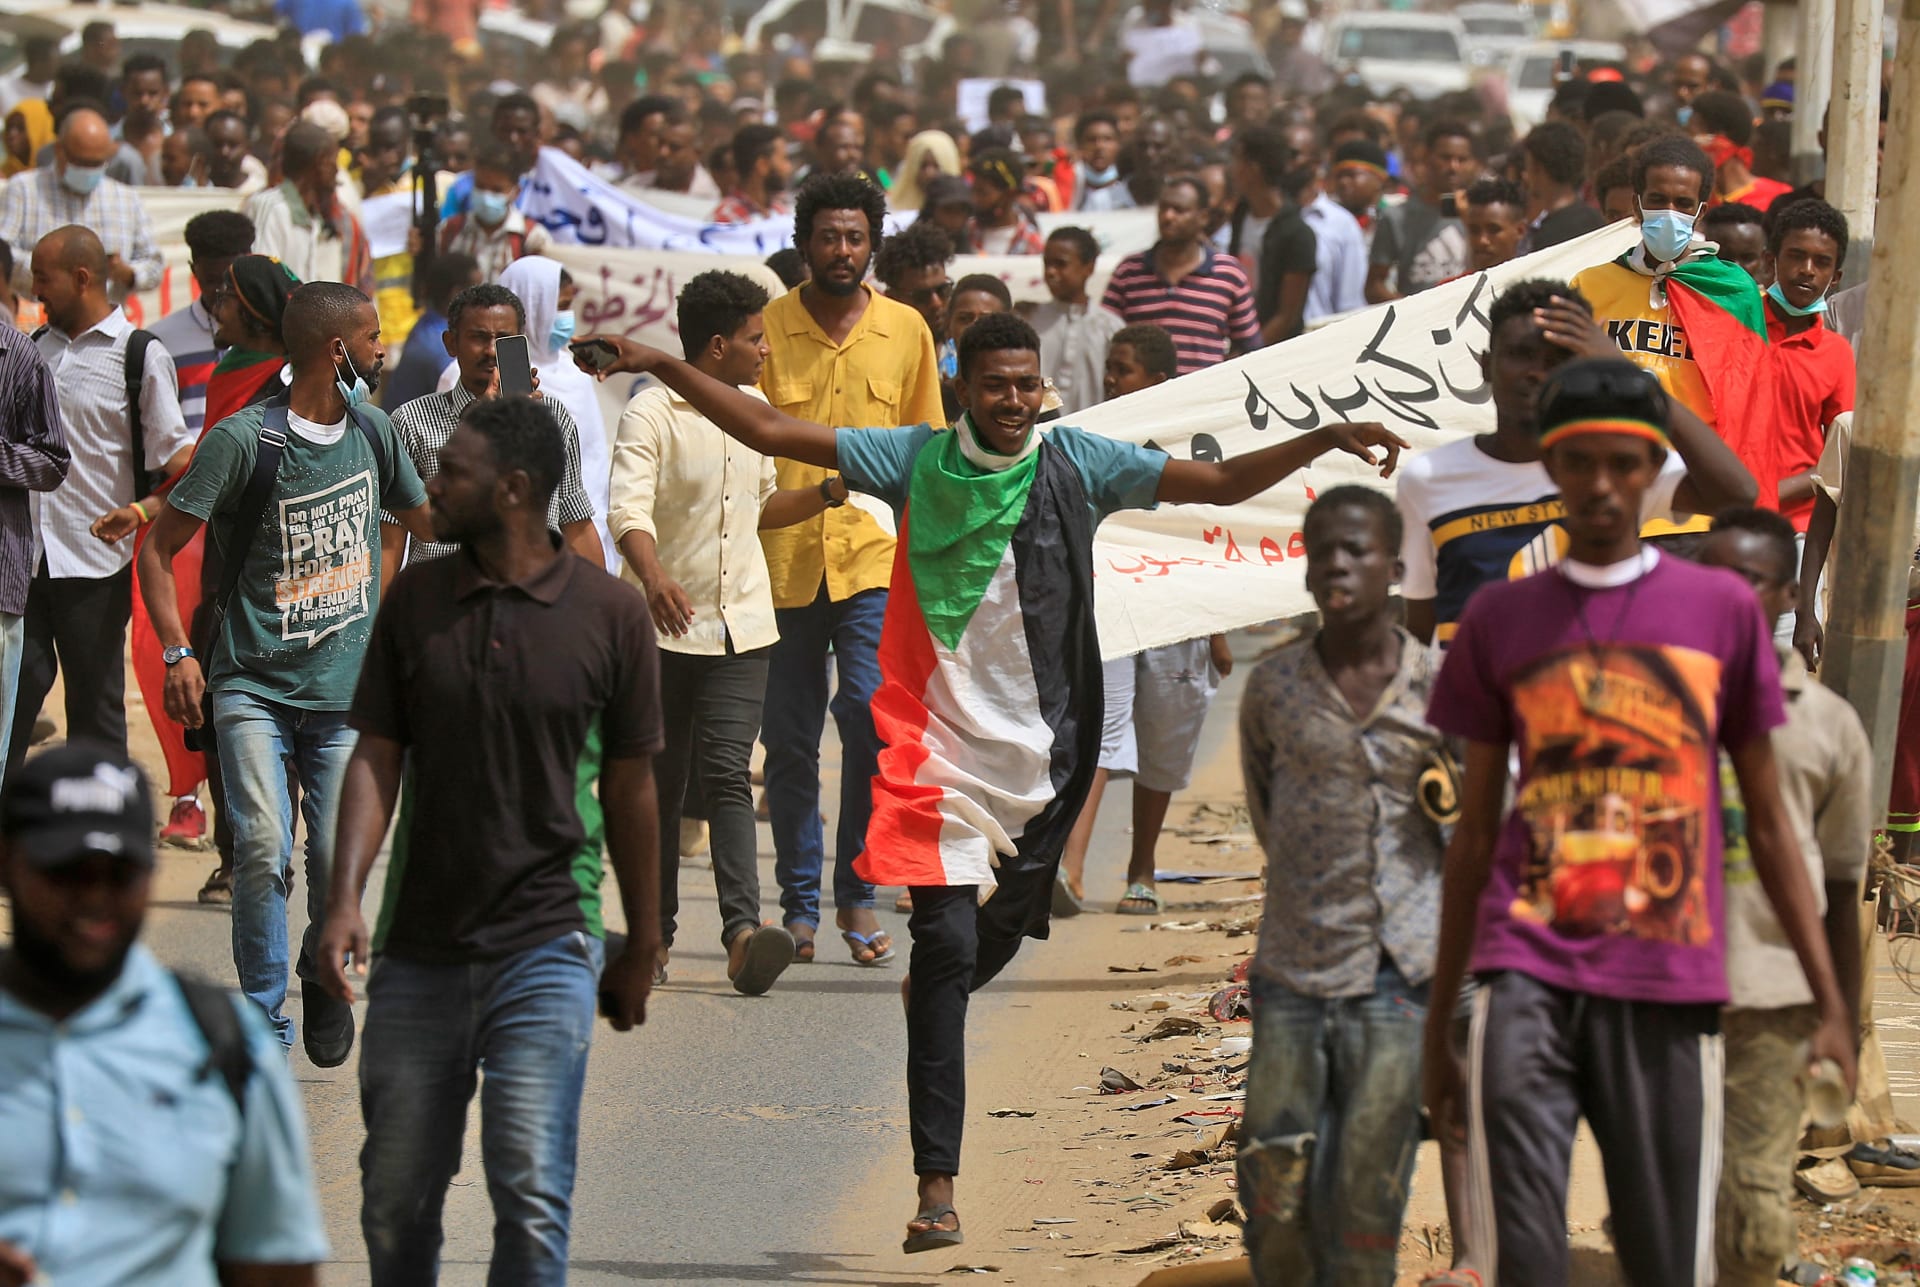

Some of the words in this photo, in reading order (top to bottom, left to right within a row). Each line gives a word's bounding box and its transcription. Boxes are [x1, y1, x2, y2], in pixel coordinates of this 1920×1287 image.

[1608, 319, 1695, 361] KEE
[288, 511, 308, 524] DO
[311, 500, 336, 519] NOT
[339, 486, 367, 510] PRAY
[1470, 509, 1518, 531] NEW
[1528, 502, 1567, 522] STY
[289, 523, 309, 535] FOR
[312, 518, 326, 530] AN
[328, 509, 350, 525] EASY
[291, 510, 367, 562] PRAY
[292, 556, 333, 580] FOR
[293, 596, 313, 612] TO
[291, 612, 299, 624] A
